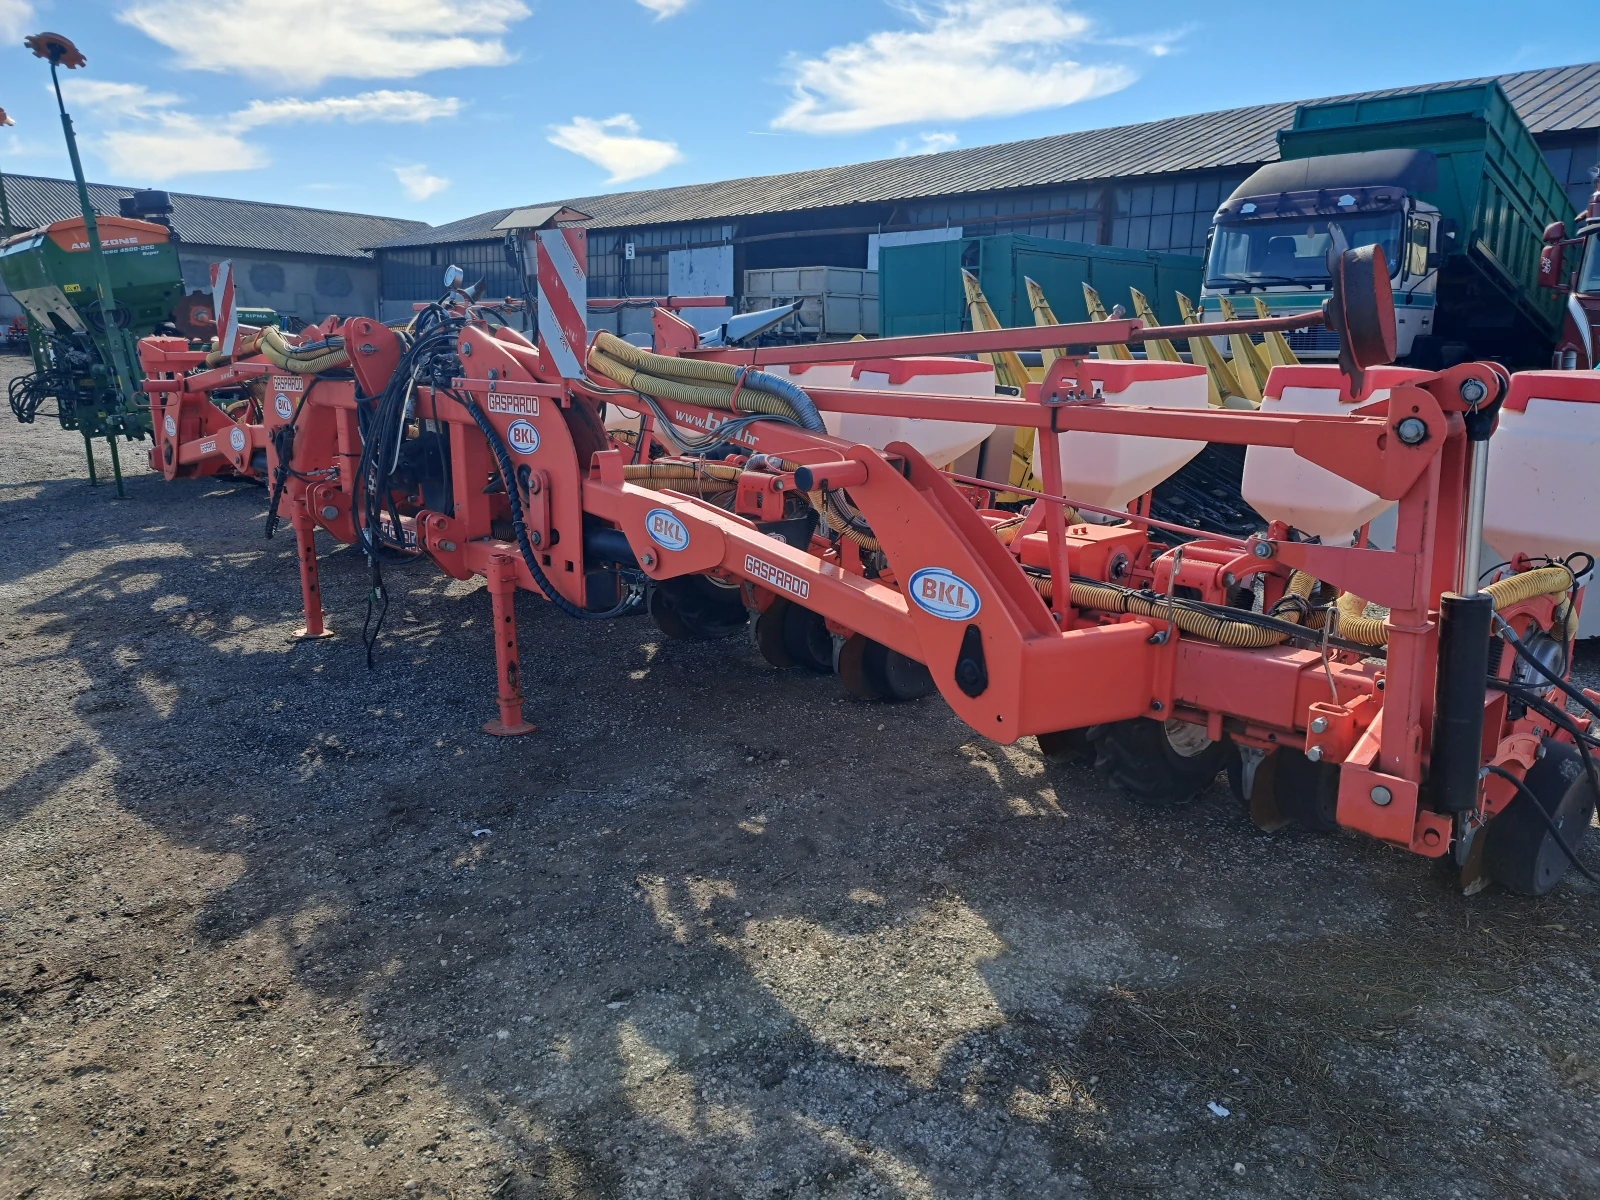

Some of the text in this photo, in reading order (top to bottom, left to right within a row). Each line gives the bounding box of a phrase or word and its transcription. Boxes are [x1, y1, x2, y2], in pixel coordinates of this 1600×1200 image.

[71, 237, 138, 249] AMZONE
[627, 245, 633, 257] 5
[274, 377, 303, 391] GASPARDO
[278, 399, 291, 412] BKL
[488, 394, 538, 414] GASPARDO
[166, 421, 175, 430] BKL
[232, 433, 243, 444] BKL
[513, 427, 536, 444] BKL
[653, 516, 684, 543] BKL
[745, 555, 809, 598] GASPARDO
[921, 577, 970, 609] BKL
